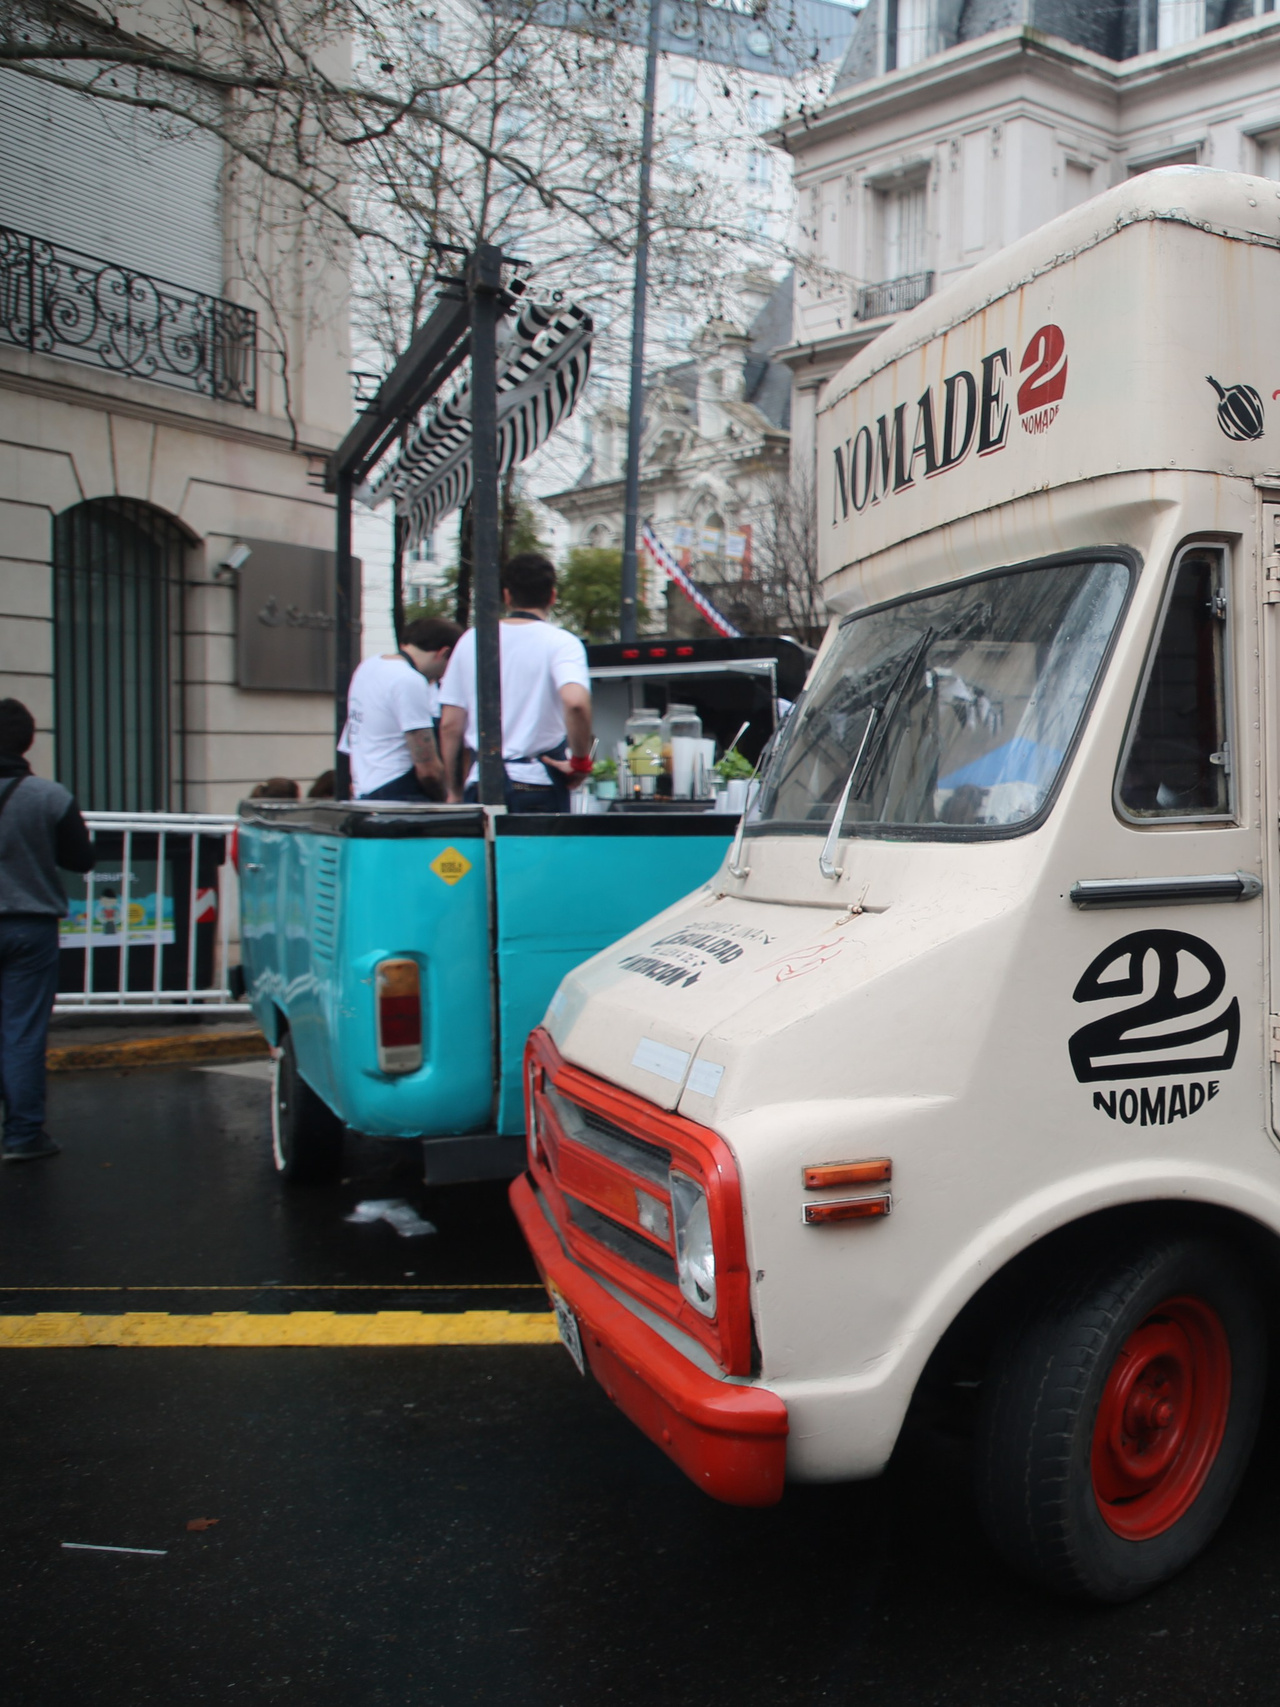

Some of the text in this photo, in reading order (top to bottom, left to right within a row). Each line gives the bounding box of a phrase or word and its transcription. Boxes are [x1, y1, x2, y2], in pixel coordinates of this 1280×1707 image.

[832, 324, 1068, 528] NOMADE 2
[1021, 404, 1060, 435] NOMADE
[1092, 1079, 1221, 1127] NOMADE
